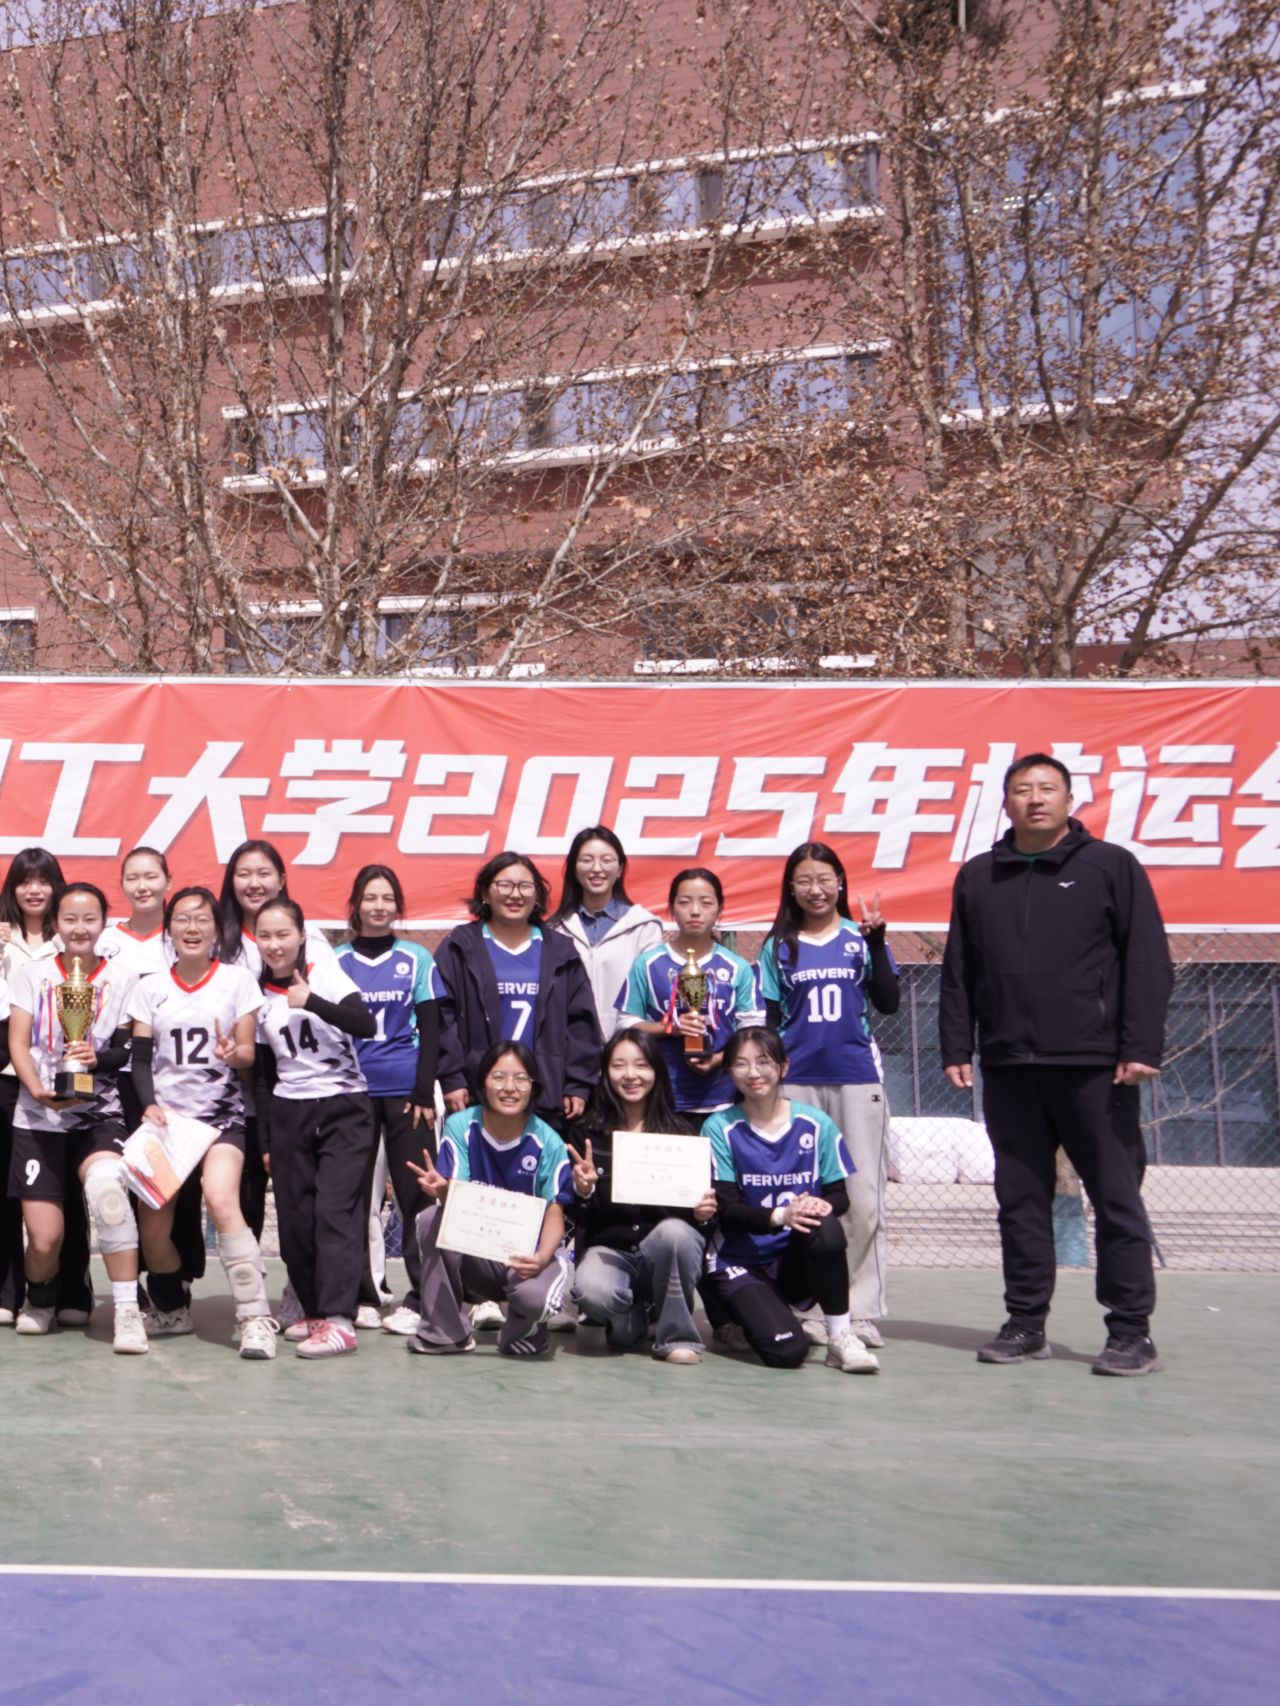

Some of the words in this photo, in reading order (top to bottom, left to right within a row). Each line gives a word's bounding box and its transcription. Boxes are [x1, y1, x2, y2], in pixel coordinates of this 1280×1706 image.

[497, 982, 540, 995] ERVE
[791, 967, 856, 984] FERVENT
[361, 990, 405, 1003] RVENT
[807, 983, 842, 1022] 10
[362, 1007, 387, 1042] 1
[510, 1000, 533, 1042] 7
[170, 1027, 209, 1066] 12
[279, 1018, 319, 1059] 14
[24, 1159, 41, 1186] 9
[742, 1171, 812, 1187] FERVENT
